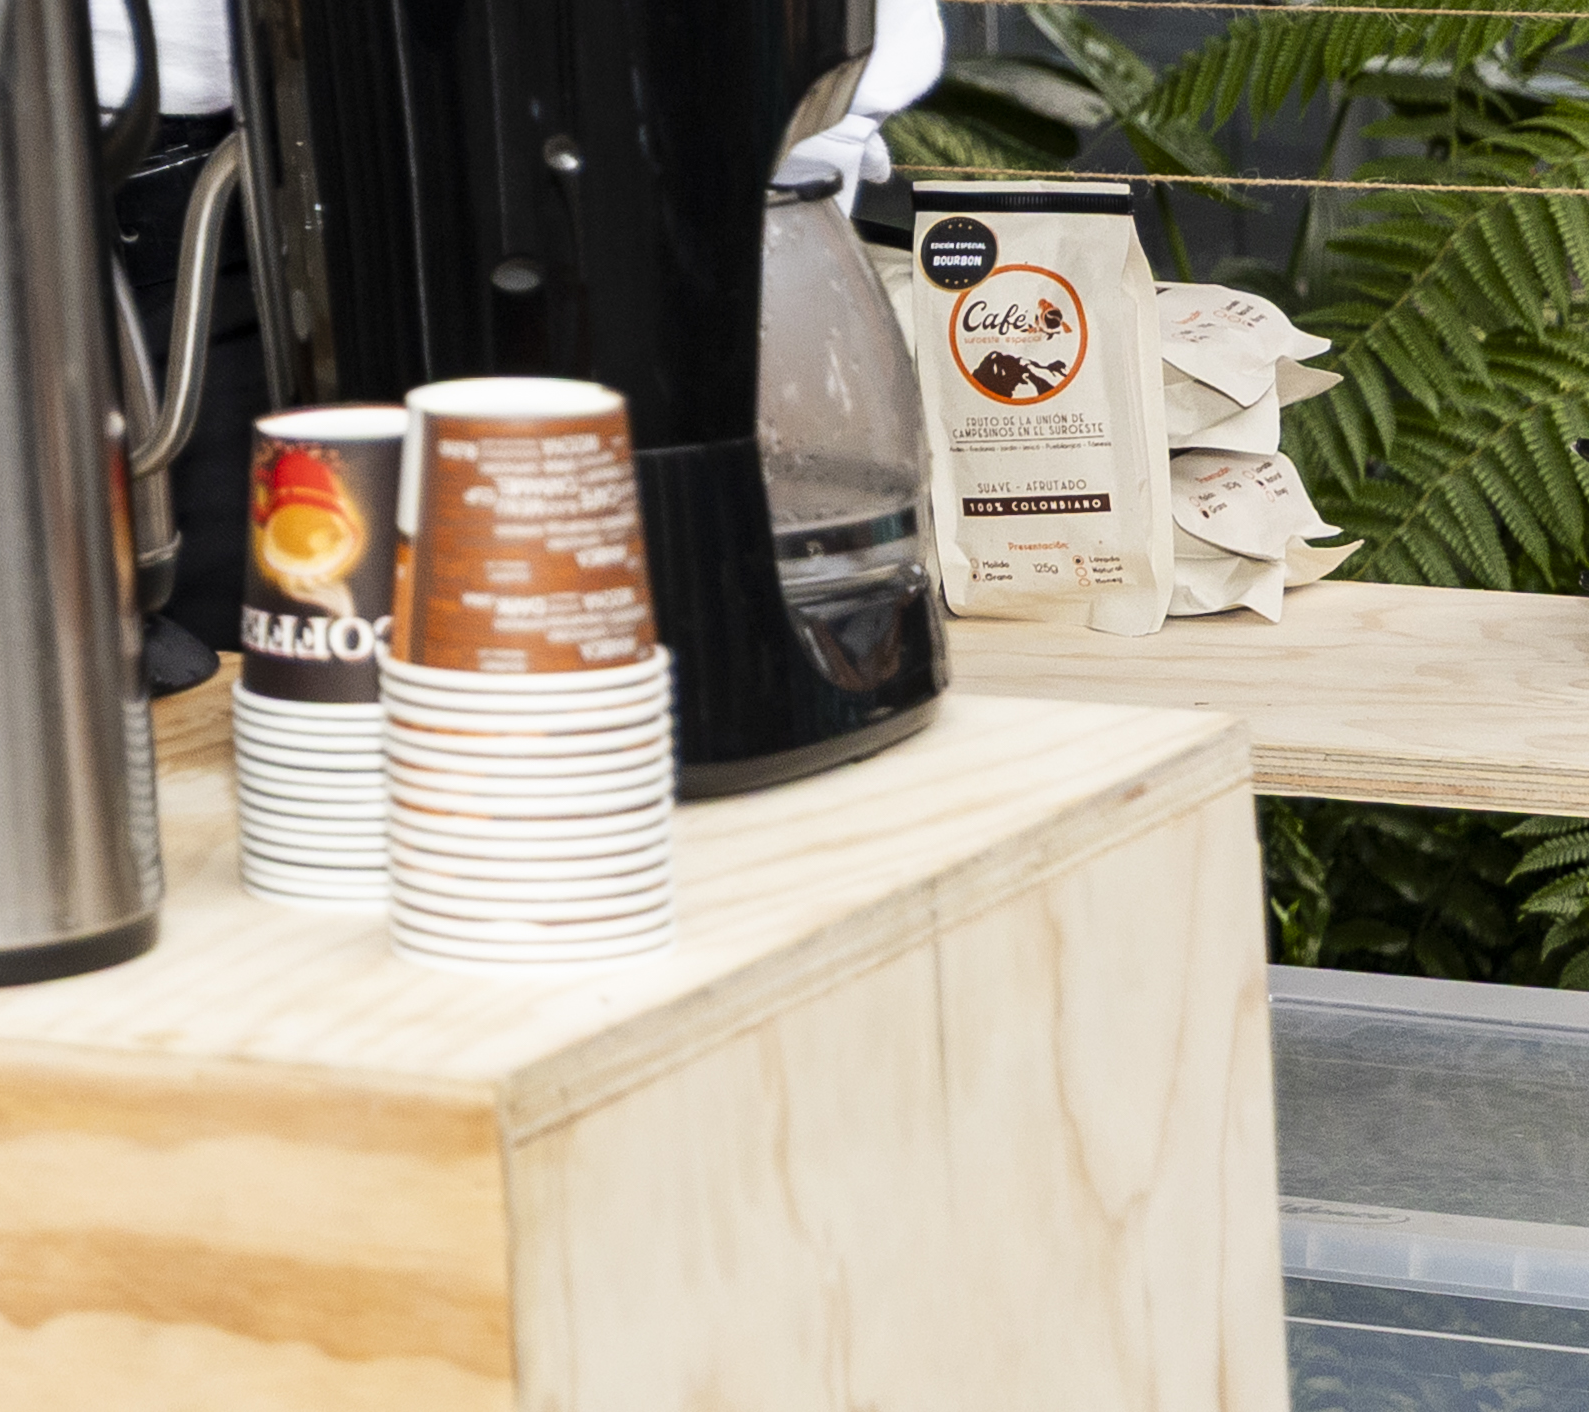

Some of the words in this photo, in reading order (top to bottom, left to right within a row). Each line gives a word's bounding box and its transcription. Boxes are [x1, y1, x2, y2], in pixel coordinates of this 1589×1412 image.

[955, 242, 986, 250] ESPECIAL
[933, 255, 982, 267] BOURBON
[963, 300, 1029, 336] Café
[964, 336, 1000, 345] suroeste
[1005, 334, 1042, 346] especial
[966, 416, 999, 427] FRUTO
[1003, 416, 1015, 427] DE
[1019, 415, 1031, 426] LA
[1036, 413, 1068, 424] UNIÓN
[1072, 413, 1084, 423] DE
[952, 427, 1015, 439] CAMPESINOS
[1018, 426, 1030, 437] EN
[1033, 426, 1044, 436] EL
[1049, 423, 1104, 435] SUROESTE
[977, 482, 1011, 494] SUAVE
[1026, 479, 1087, 492] AFRUTADO
[969, 502, 1004, 513] 100%
[1011, 498, 1102, 511] COLOMBIANO
